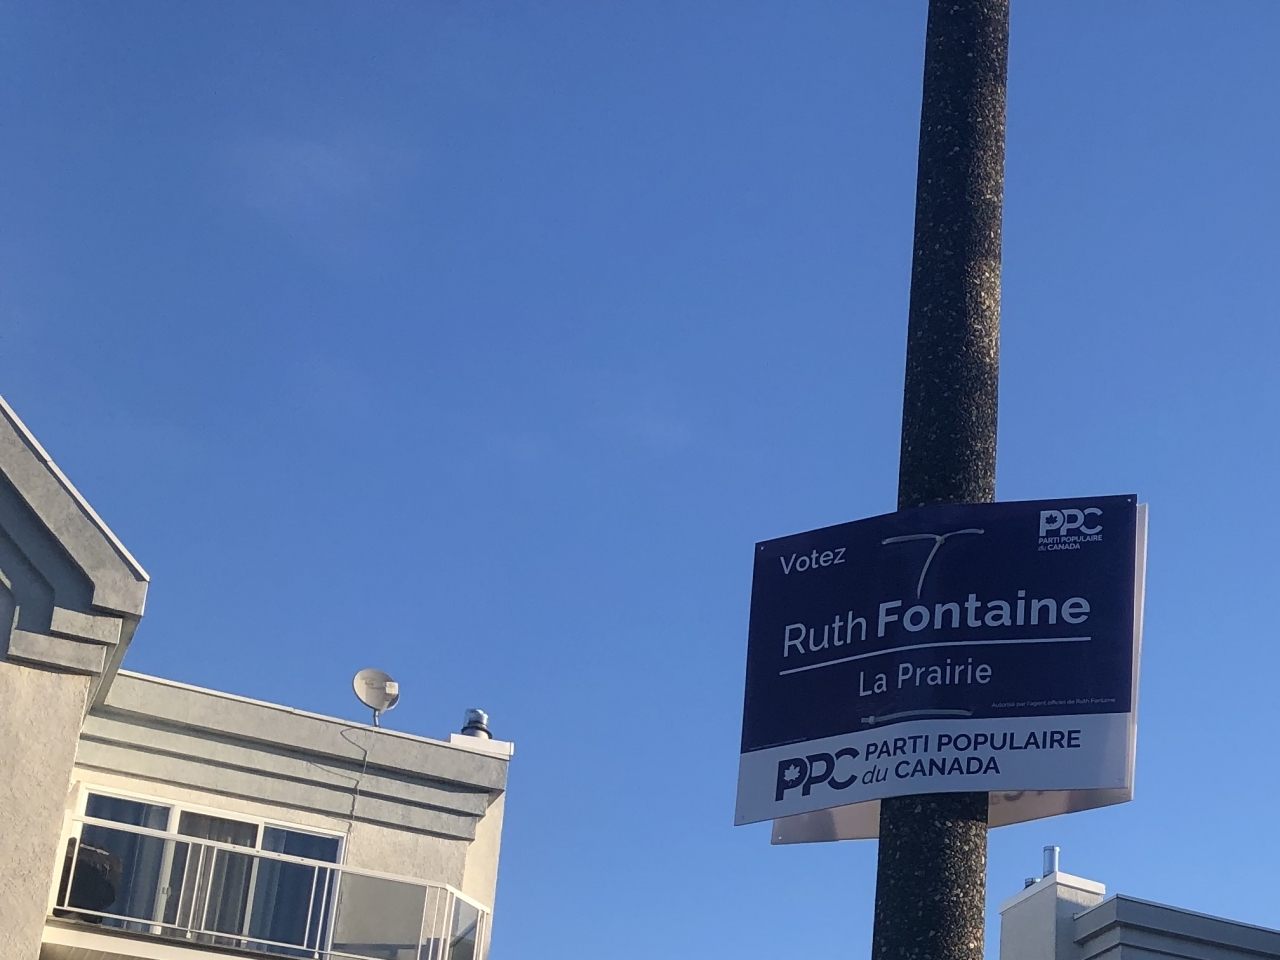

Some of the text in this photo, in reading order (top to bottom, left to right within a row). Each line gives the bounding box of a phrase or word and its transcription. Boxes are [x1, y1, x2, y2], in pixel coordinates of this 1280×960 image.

[1039, 508, 1103, 536] PPC
[1038, 535, 1103, 544] PARTI POPULAIRE
[1047, 543, 1081, 551] CANADA
[780, 547, 846, 575] Votez
[783, 590, 1091, 658] Ruth Fontaine
[859, 658, 992, 697] La Prairie
[864, 730, 1081, 761] PARTI POPULAIRE
[775, 747, 860, 801] PPC
[862, 756, 1001, 785] du CANADA
